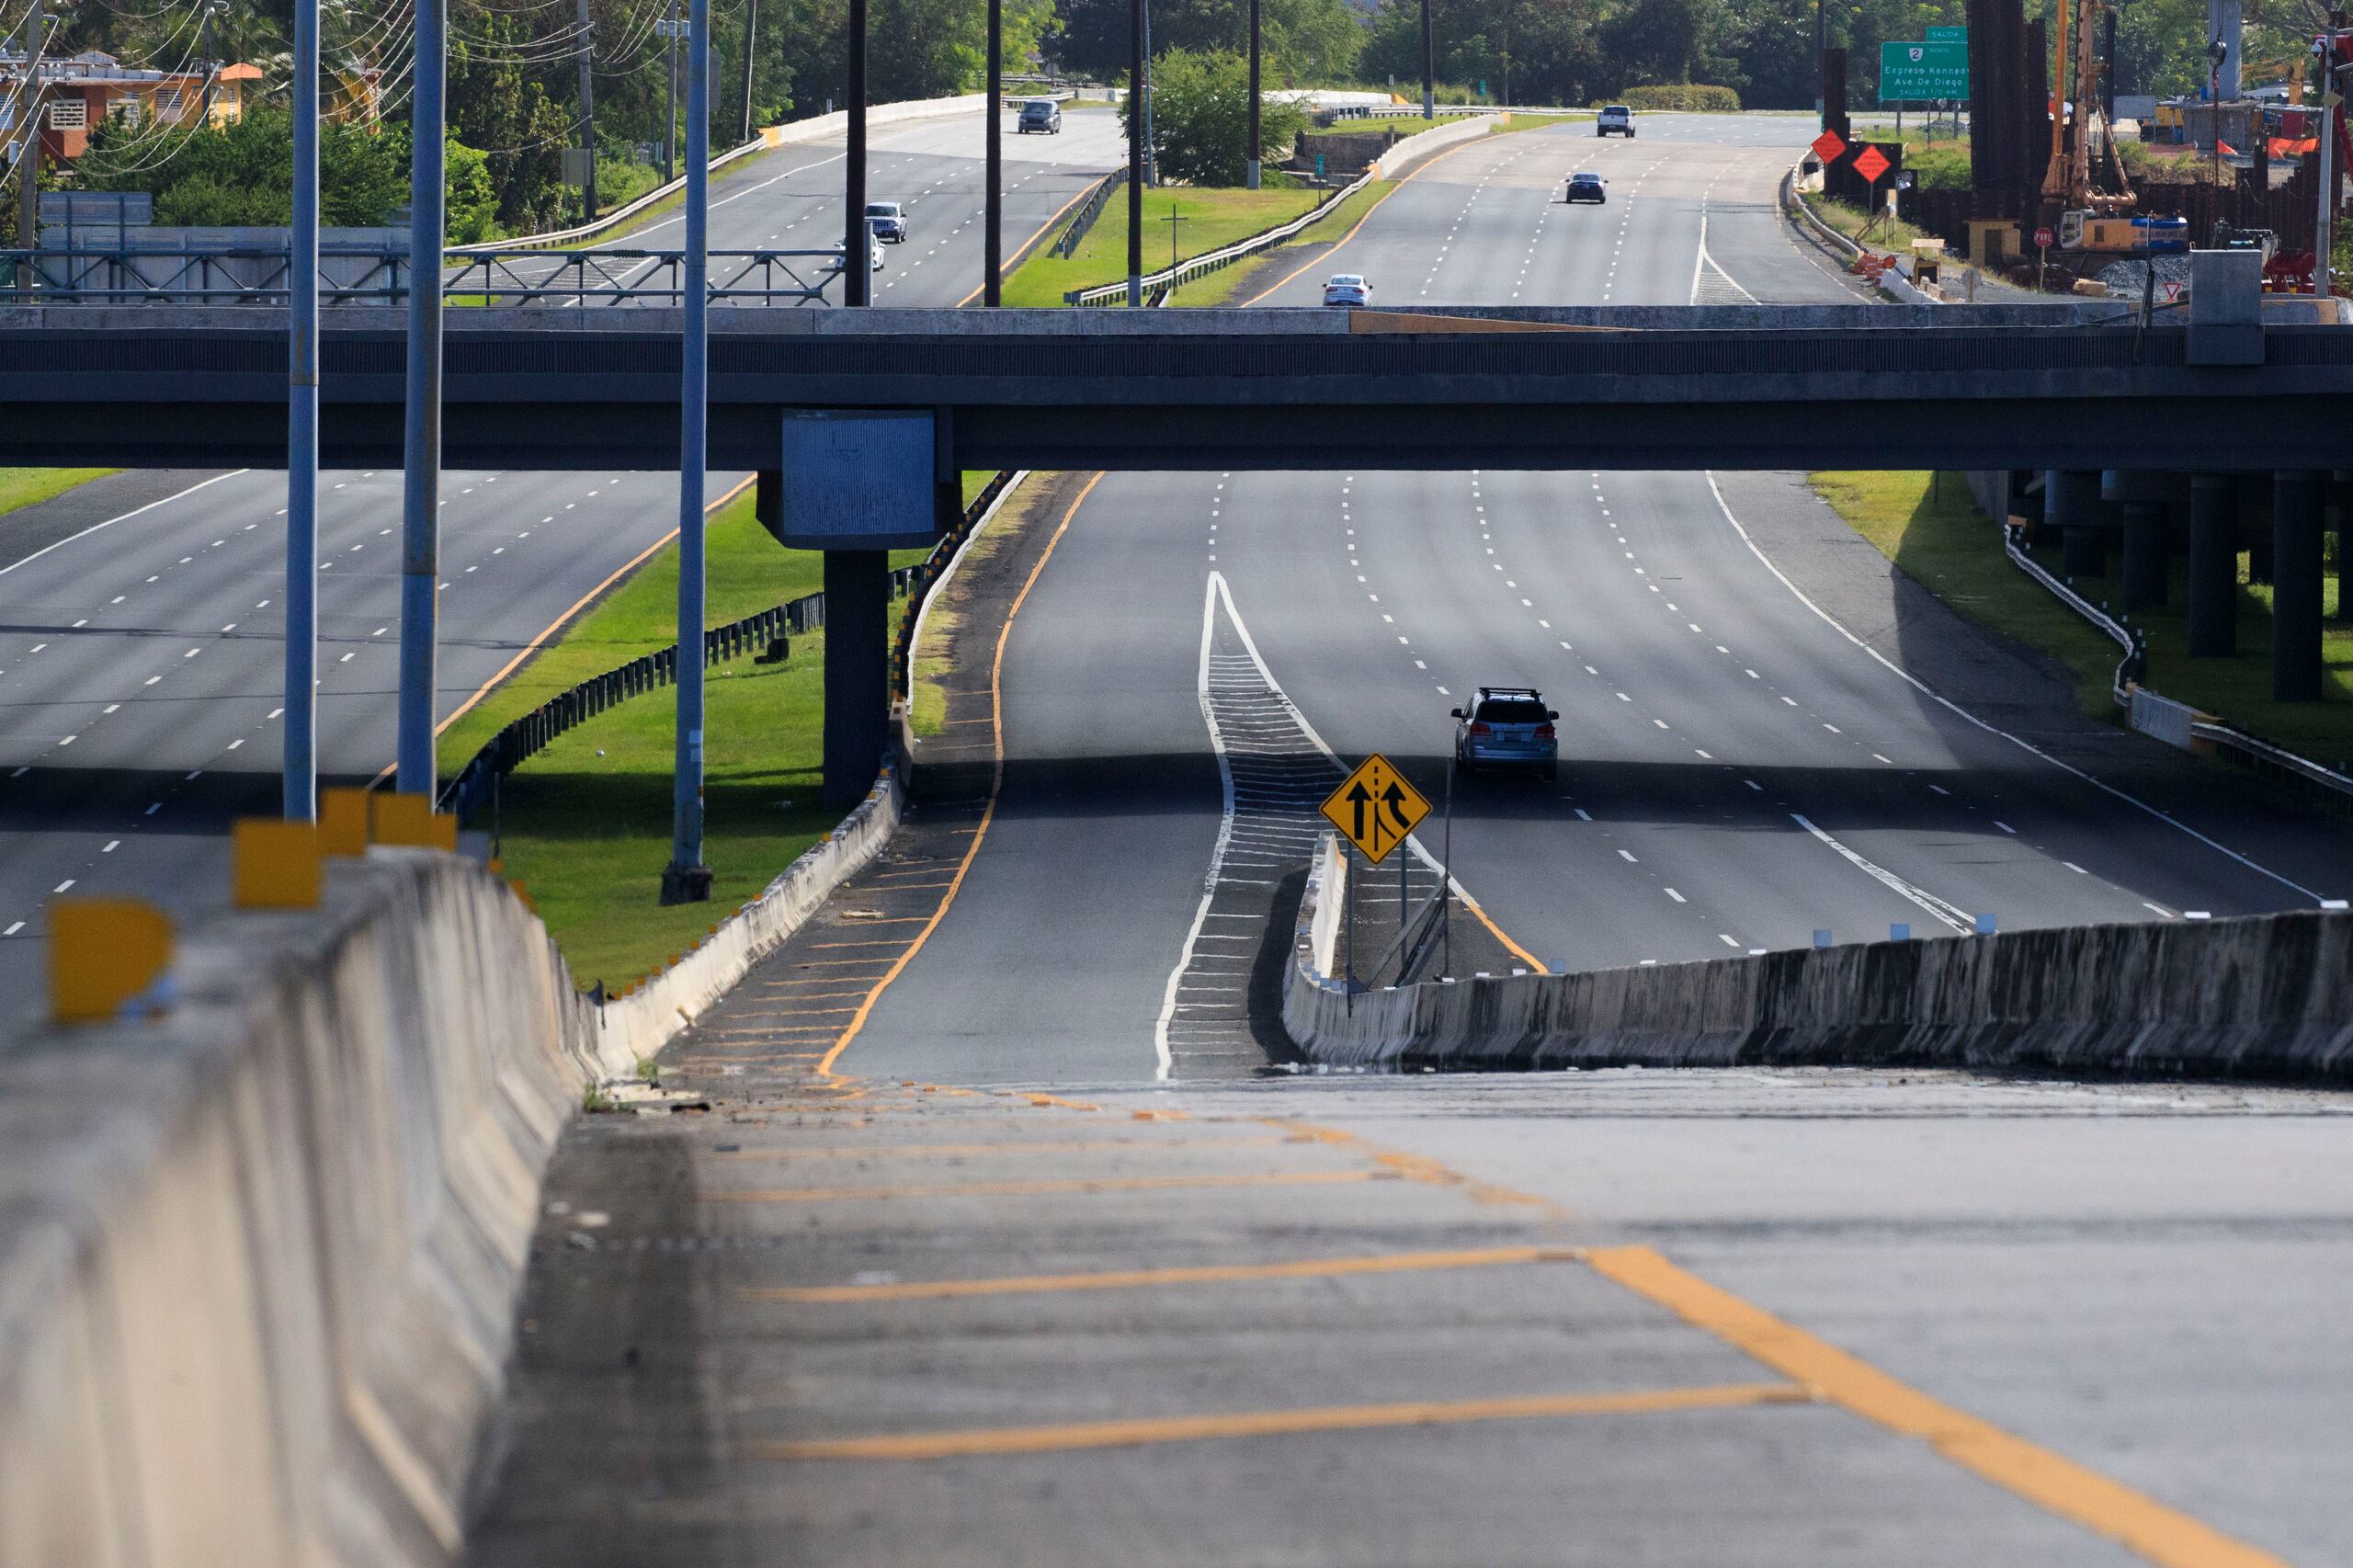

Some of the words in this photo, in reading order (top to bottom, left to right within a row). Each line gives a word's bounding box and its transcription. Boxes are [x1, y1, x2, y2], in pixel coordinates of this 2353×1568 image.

[1913, 50, 1919, 59] 2
[1885, 67, 1925, 76] Expreso
[1935, 78, 1962, 87] Diego
[2035, 233, 2052, 242] PARE
